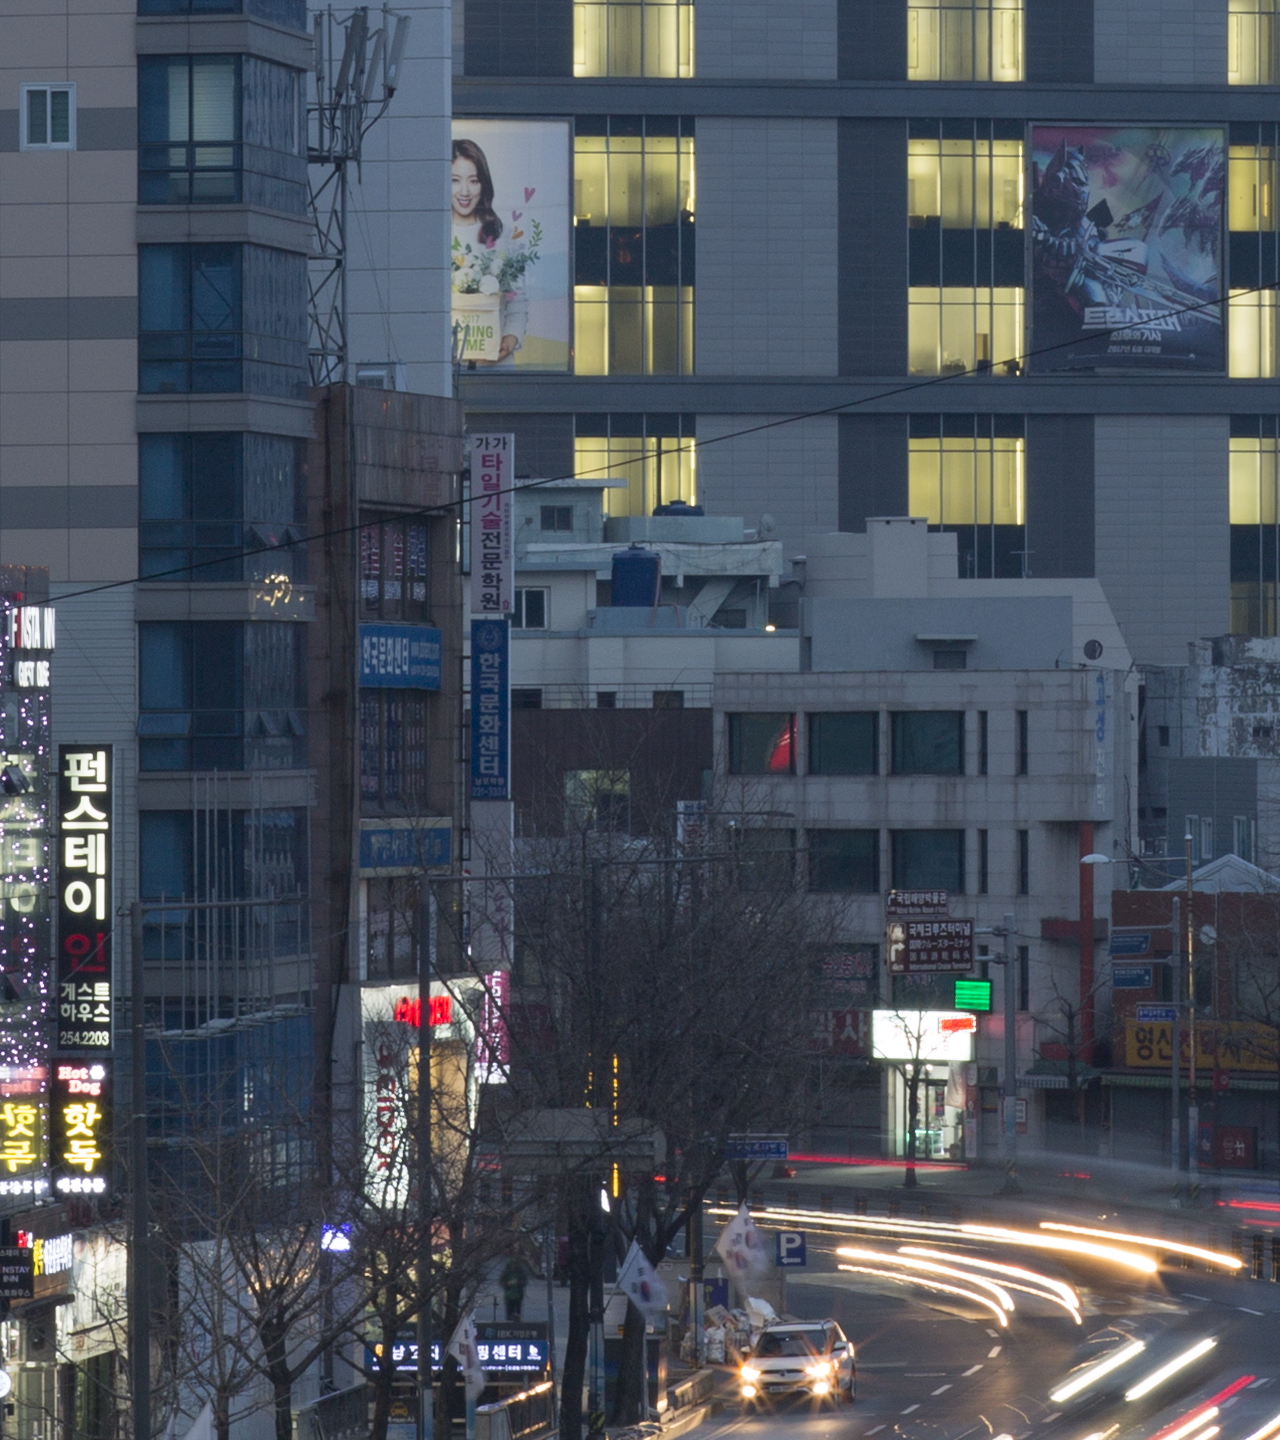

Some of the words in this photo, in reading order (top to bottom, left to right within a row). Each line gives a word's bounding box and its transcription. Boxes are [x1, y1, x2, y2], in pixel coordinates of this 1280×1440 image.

[474, 436, 508, 452] 가가
[480, 452, 503, 611] 타일기술전문학원
[363, 636, 410, 676] 한국문화센터
[478, 653, 501, 776] 한국문화센터
[62, 751, 108, 920] 펀스테이
[909, 923, 971, 937] 국제크루즈터미널
[64, 933, 106, 972] 인
[60, 982, 110, 1002] 게스트
[60, 1003, 110, 1022] 하우스
[60, 1030, 110, 1046] 254.2203
[58, 1067, 89, 1080] Hot
[69, 1080, 101, 1096] Dog
[63, 1102, 102, 1173] 핫독
[779, 1232, 802, 1257] P
